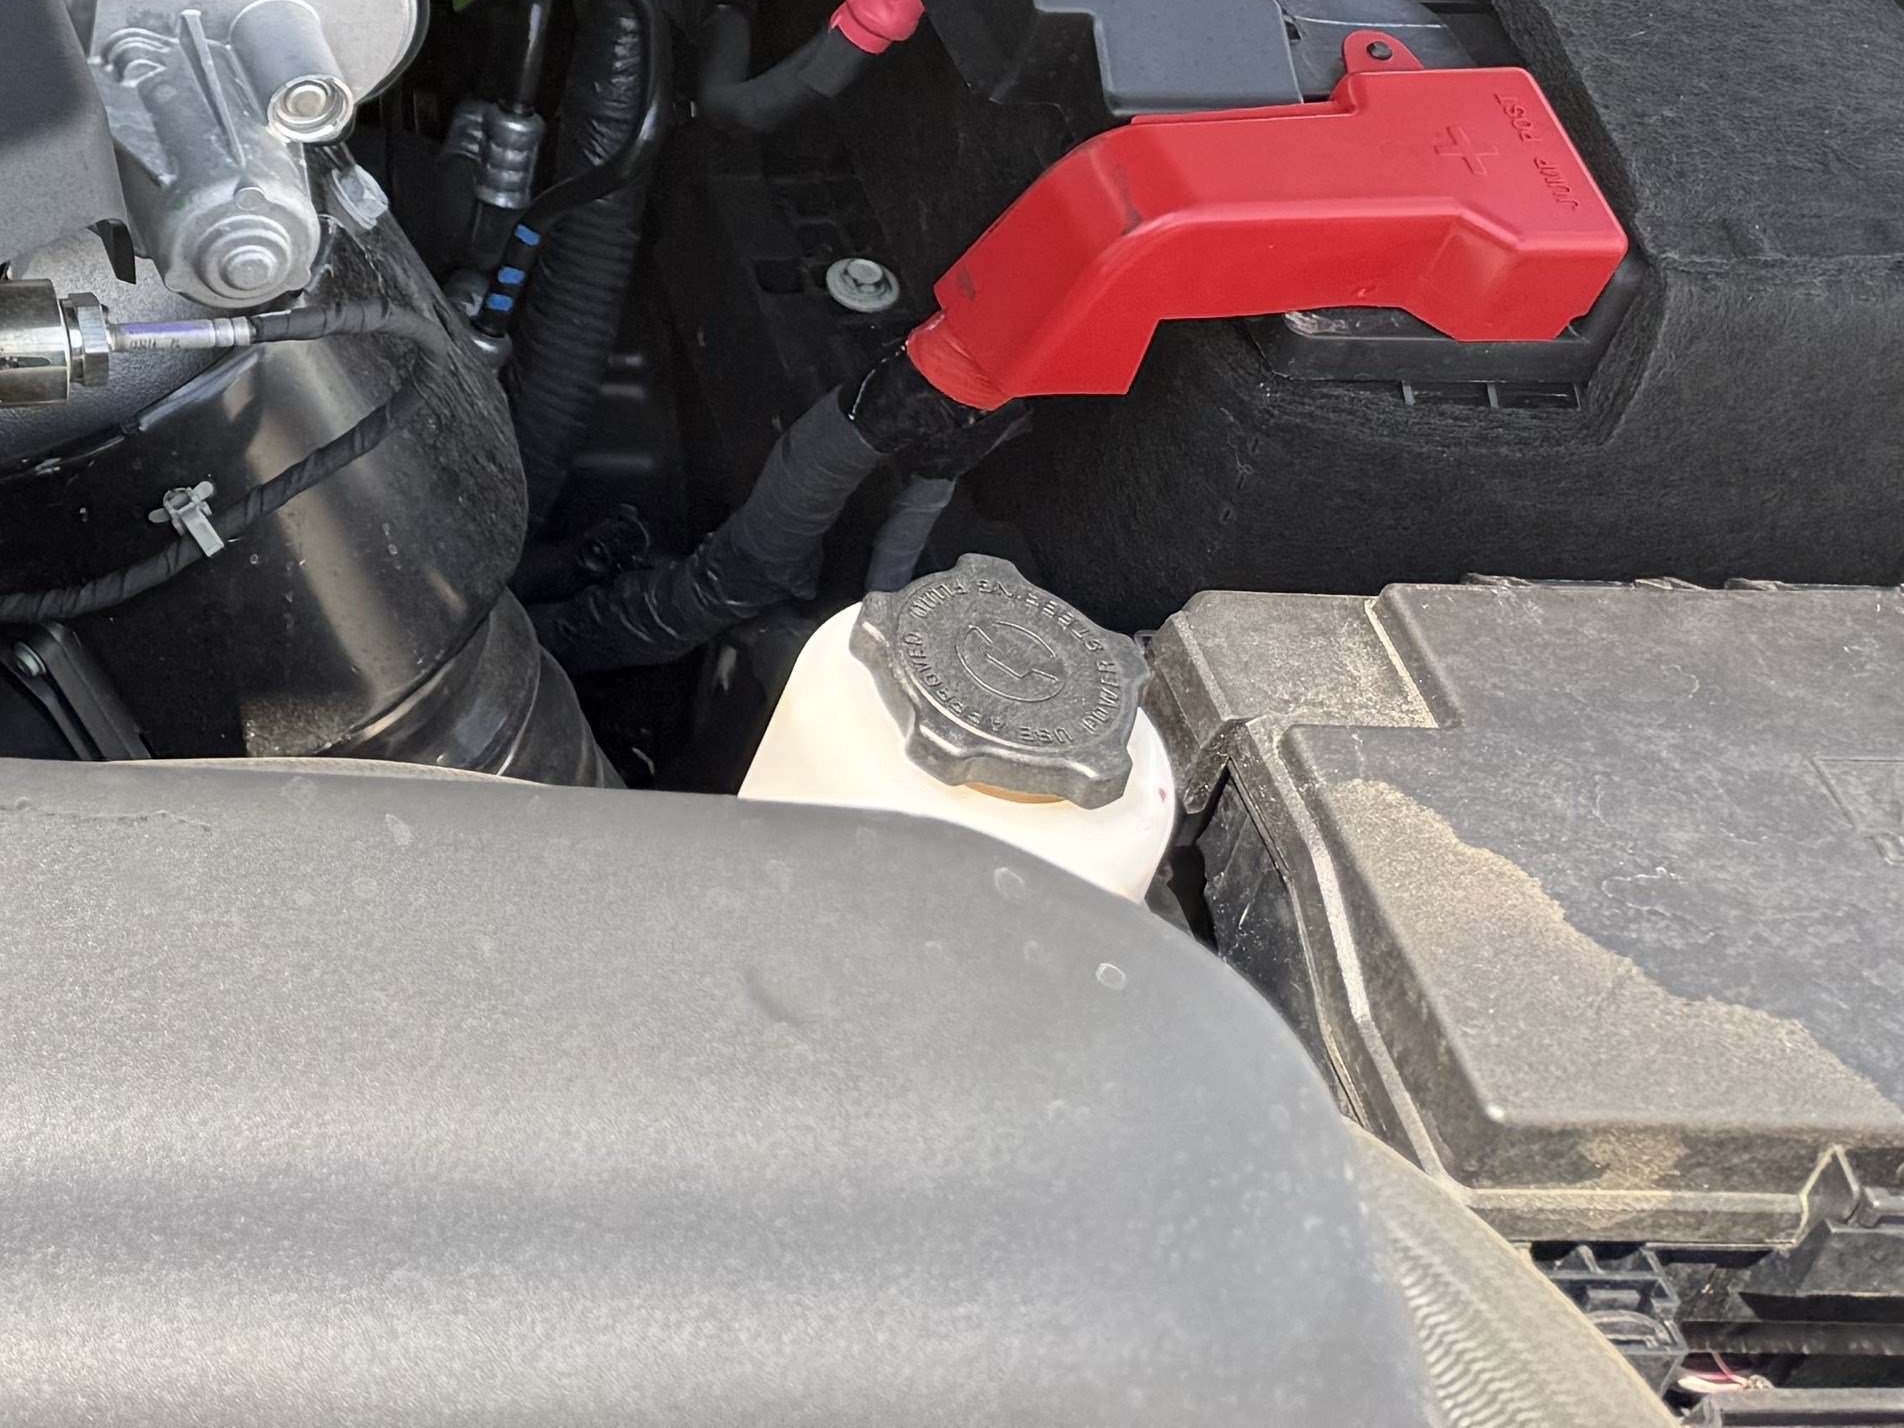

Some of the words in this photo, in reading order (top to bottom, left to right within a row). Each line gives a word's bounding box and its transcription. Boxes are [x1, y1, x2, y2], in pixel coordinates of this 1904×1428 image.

[1494, 93, 1542, 143] POST
[1533, 156, 1579, 211] JUMP
[910, 580, 968, 619] FLUID
[904, 632, 1005, 731] APPROVED
[1083, 660, 1121, 735] POWER
[1019, 726, 1074, 744] USE
